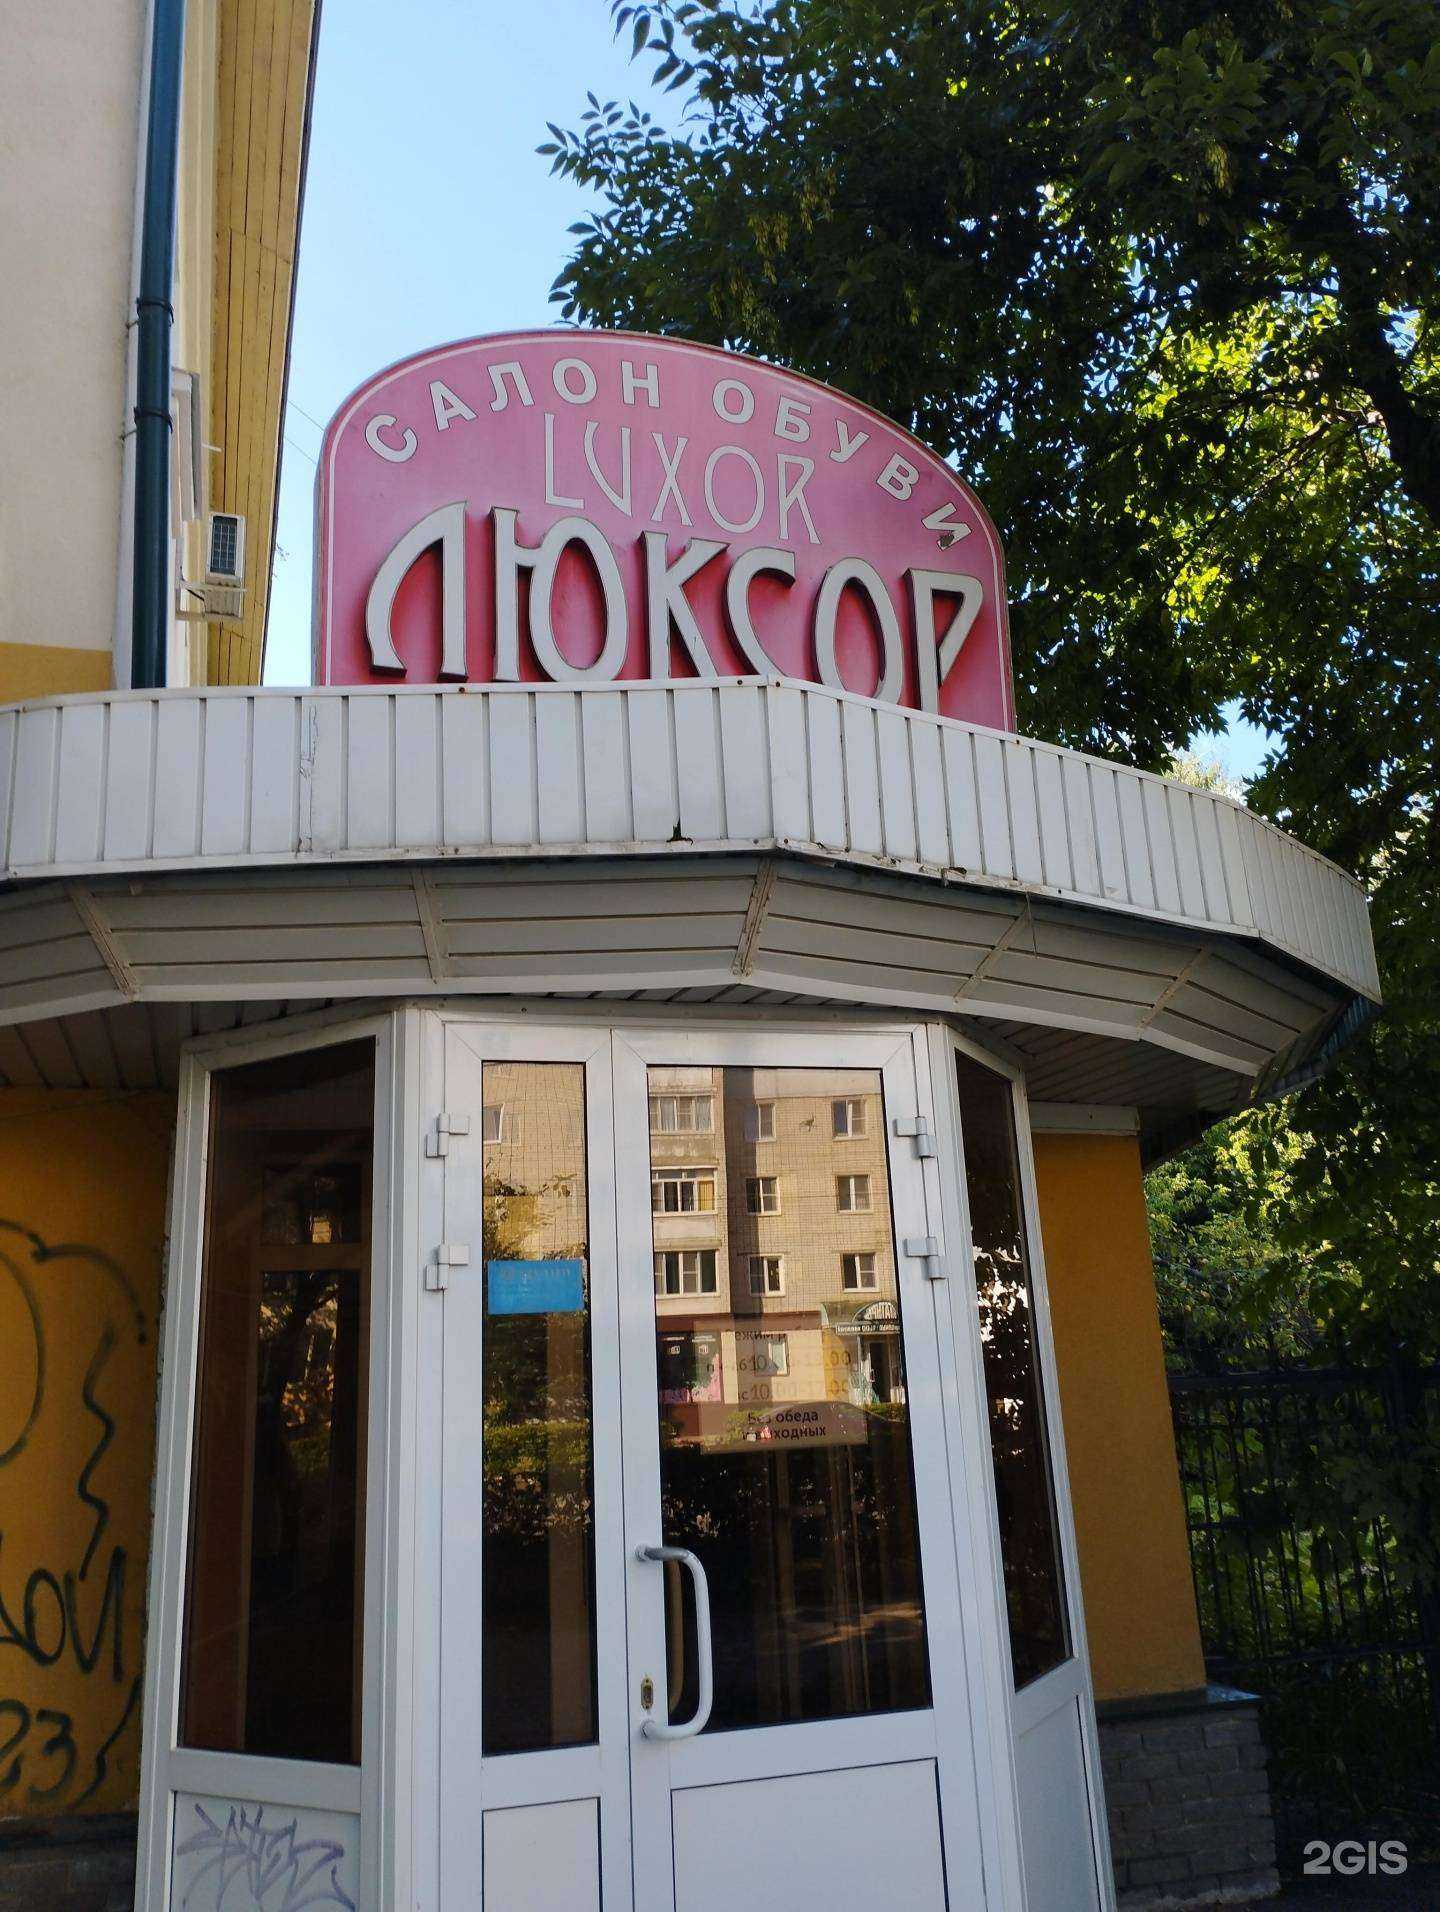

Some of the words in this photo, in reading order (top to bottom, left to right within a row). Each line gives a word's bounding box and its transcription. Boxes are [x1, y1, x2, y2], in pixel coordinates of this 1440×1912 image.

[364, 357, 661, 464] САЛОН
[712, 378, 973, 551] ОБУВИ
[364, 501, 985, 714] ЛЮКСОР
[775, 1409, 819, 1423] обеда
